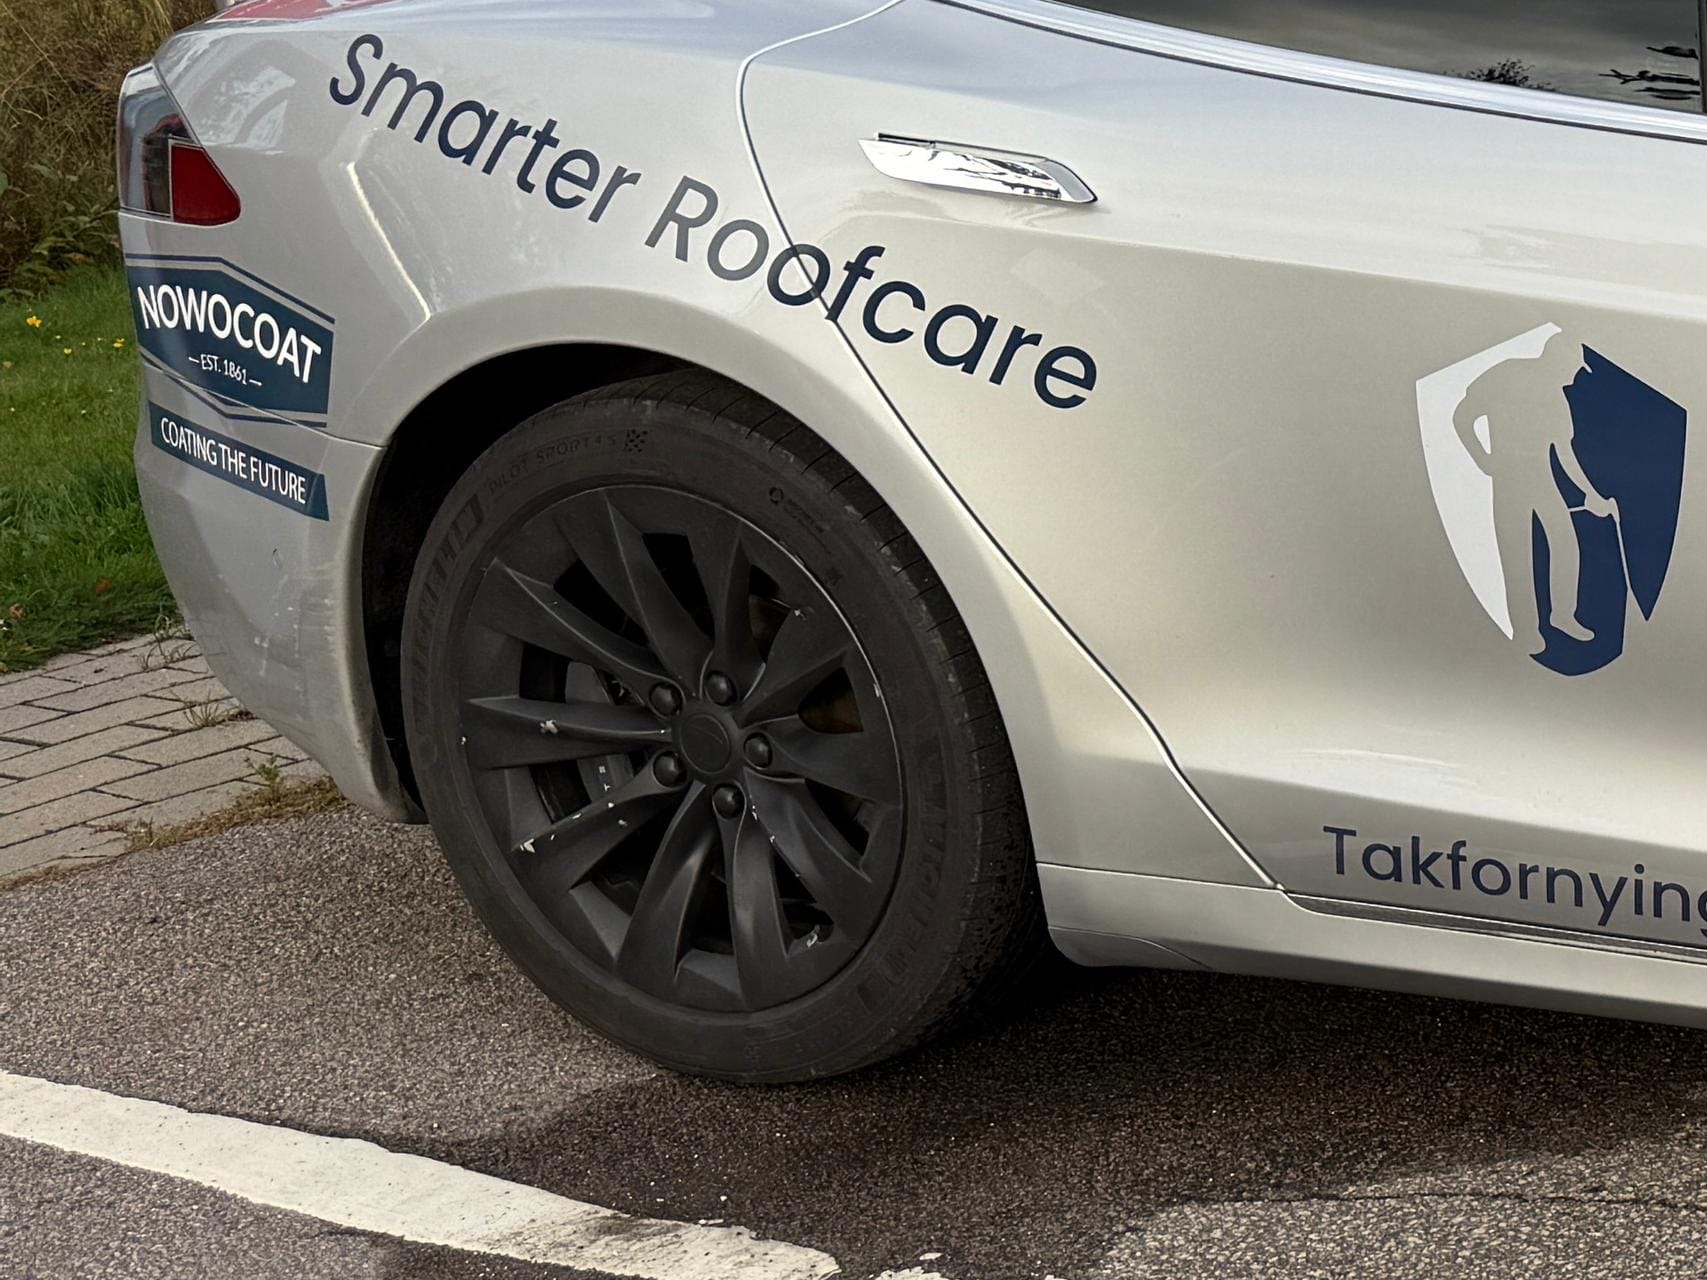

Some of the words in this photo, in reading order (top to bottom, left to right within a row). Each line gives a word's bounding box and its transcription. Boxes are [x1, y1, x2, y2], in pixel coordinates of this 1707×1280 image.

[328, 33, 641, 225] Smarter
[644, 175, 1098, 410] Roofcare
[137, 284, 321, 383] NOWOCOAT
[161, 417, 217, 466] COATING
[219, 442, 248, 479] THE
[250, 457, 306, 504] FUTURE
